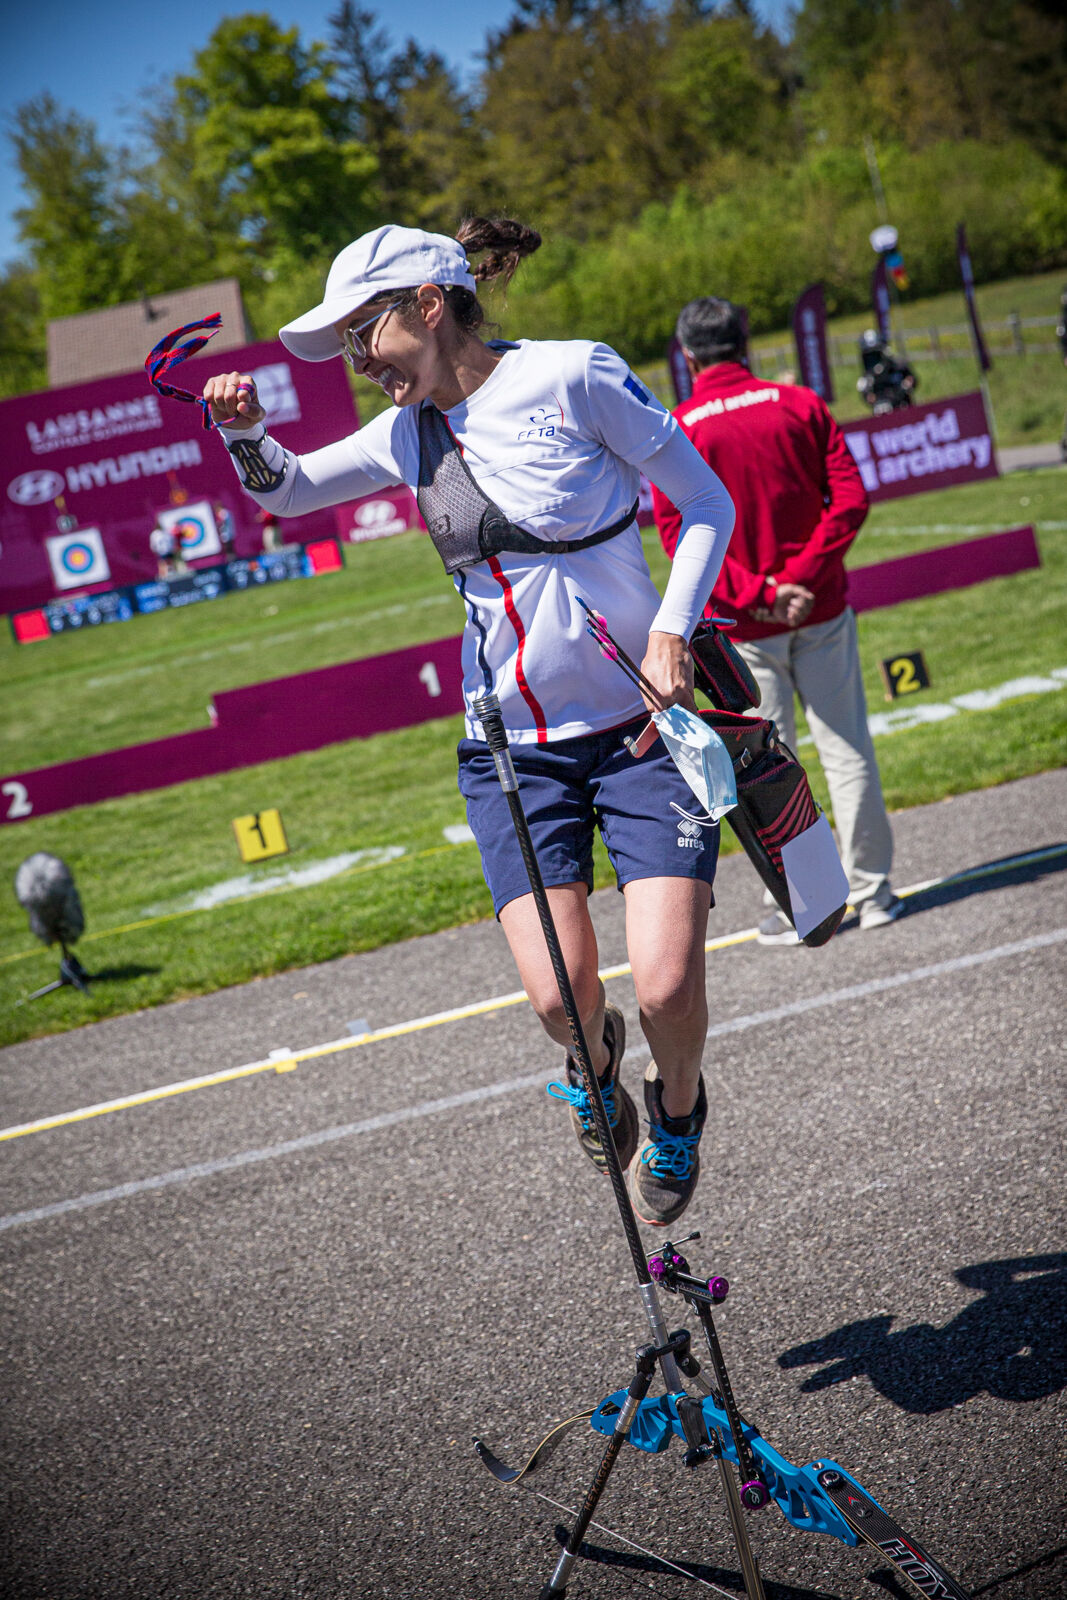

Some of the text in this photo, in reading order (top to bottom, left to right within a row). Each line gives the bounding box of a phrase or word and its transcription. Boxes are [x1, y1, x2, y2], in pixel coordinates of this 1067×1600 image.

[26, 394, 159, 446] LAUSANNE
[682, 388, 780, 427] world archery
[871, 408, 960, 457] world
[65, 439, 202, 493] HYUNDAI
[878, 434, 991, 484] archery
[419, 661, 441, 697] 1
[890, 657, 920, 693] 2
[2, 781, 33, 819] 2
[249, 813, 267, 849] 1
